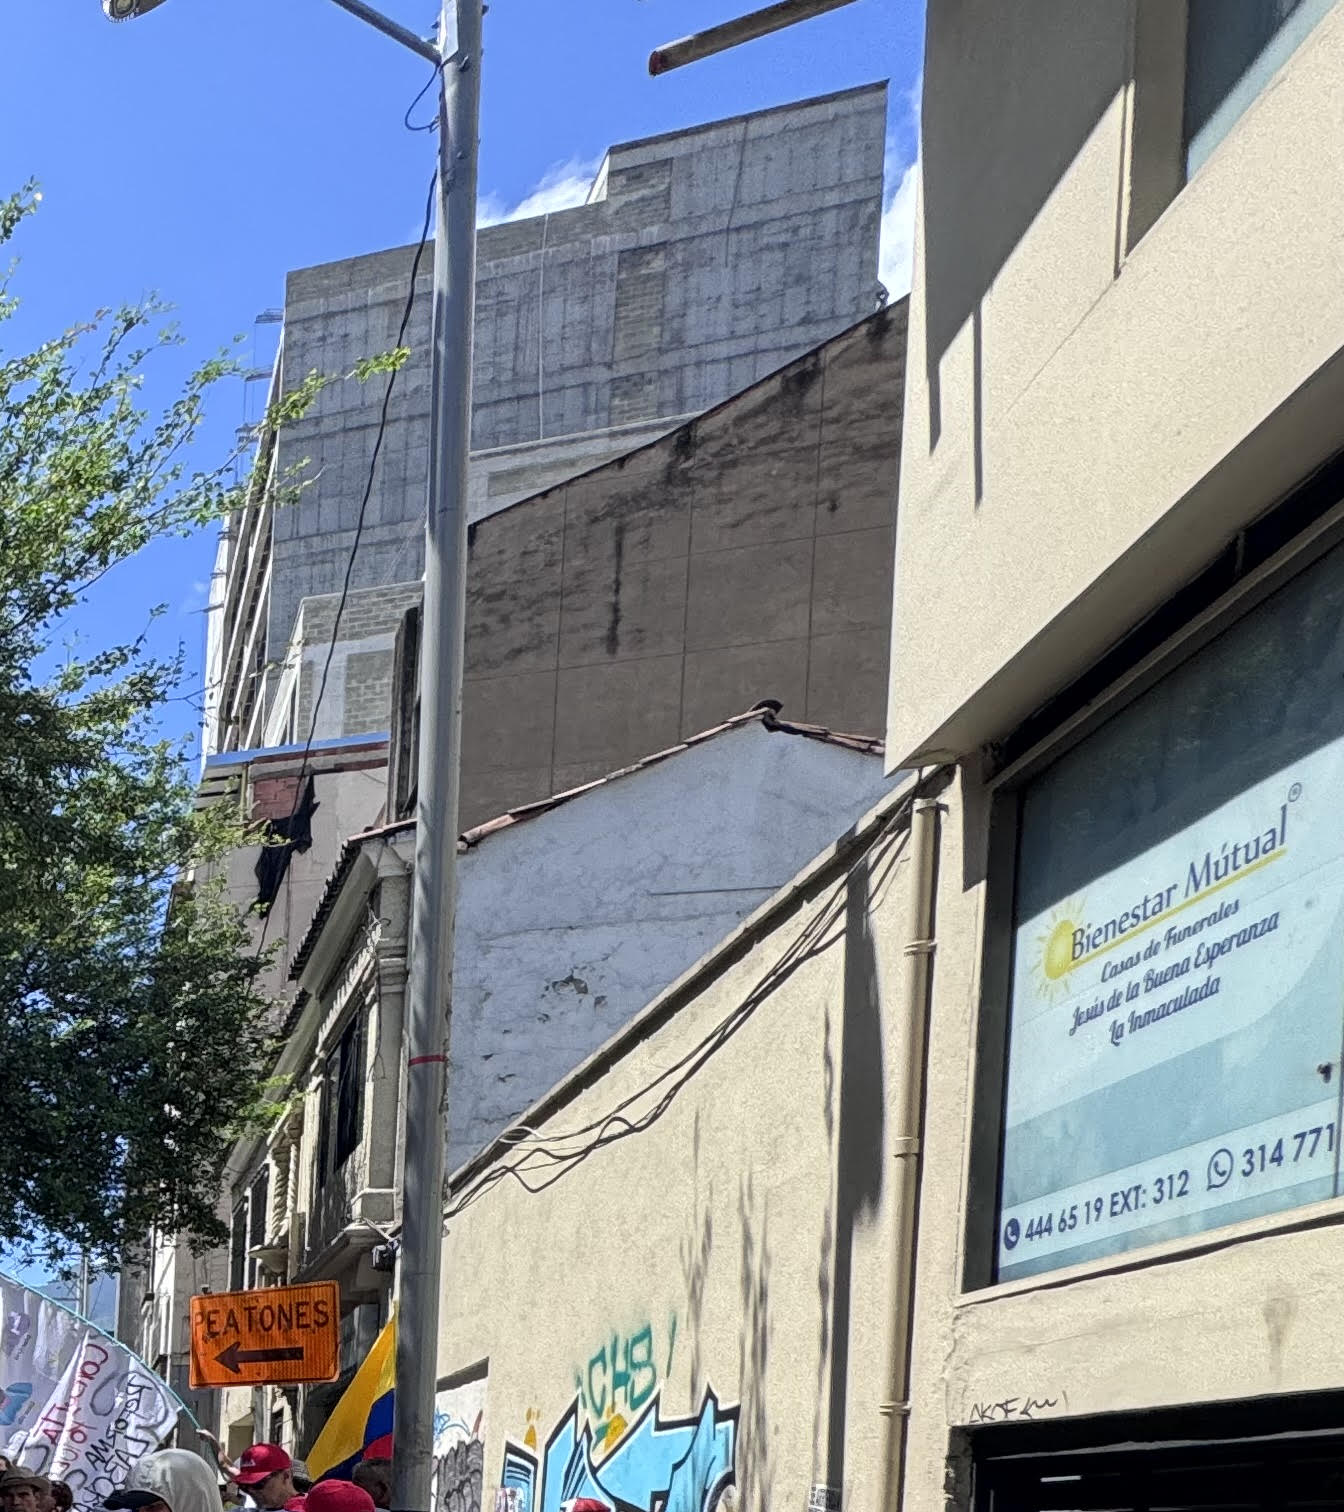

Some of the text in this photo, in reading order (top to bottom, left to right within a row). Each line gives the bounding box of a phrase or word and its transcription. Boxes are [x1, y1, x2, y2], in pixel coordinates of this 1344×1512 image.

[1070, 803, 1287, 962] Bienestar Mútual
[1069, 911, 1280, 1036] Jesús de la Buena Esperanza
[1100, 898, 1240, 984] Casas de Funerales
[1128, 976, 1222, 1034] Inmaculada
[1025, 1122, 1336, 1242] 444 65 19 EXT: 312 314 771
[193, 1299, 330, 1338] PEATONES
